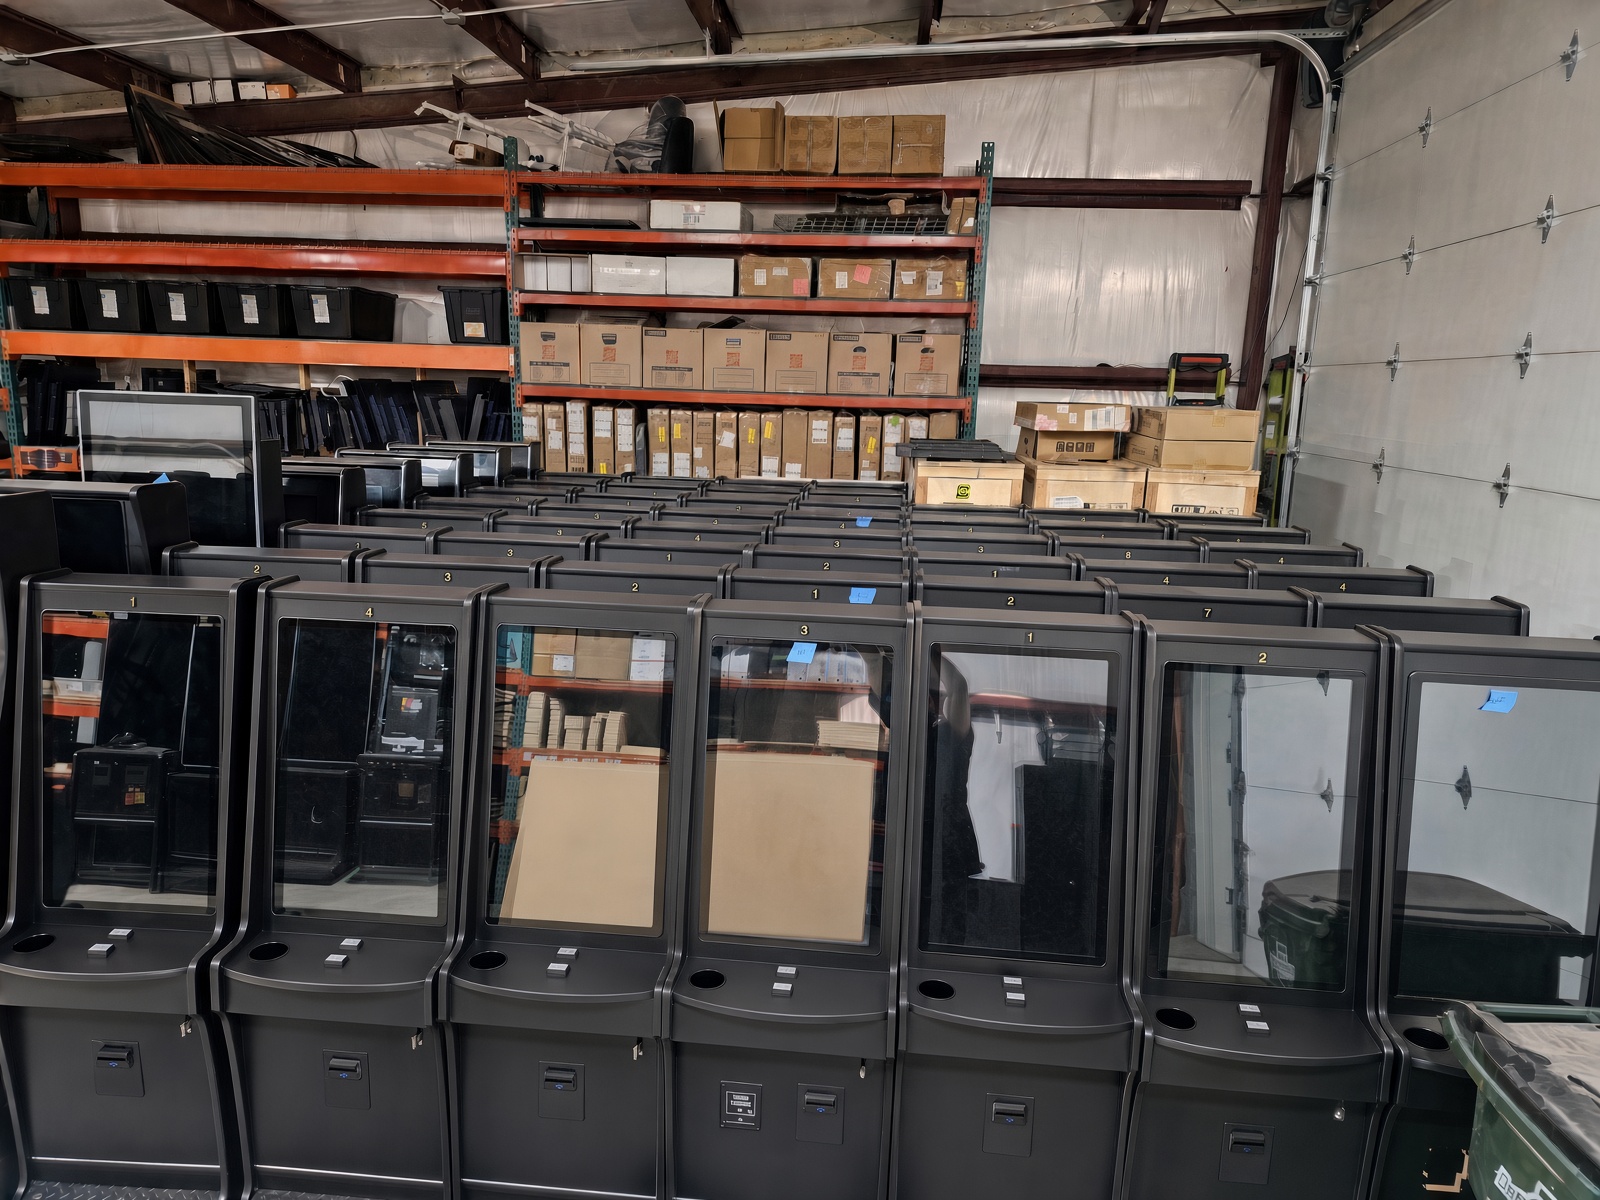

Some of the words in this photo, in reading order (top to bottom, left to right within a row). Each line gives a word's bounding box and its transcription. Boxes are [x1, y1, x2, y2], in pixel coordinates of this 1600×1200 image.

[421, 521, 427, 529] 5
[507, 548, 513, 557] 3
[978, 545, 984, 553] 3
[666, 553, 671, 561] 1
[1125, 551, 1131, 559] 8
[253, 564, 260, 574] 2
[823, 562, 830, 570] 2
[444, 572, 451, 582] 3
[992, 570, 997, 578] 1
[1163, 576, 1170, 585] 4
[632, 582, 639, 592] 2
[1339, 582, 1346, 591] 4
[812, 588, 818, 599] 1
[130, 596, 135, 607] 1
[1007, 596, 1014, 606] 2
[365, 607, 373, 618] 4
[1204, 608, 1211, 618] 7
[800, 624, 808, 635] 3
[1027, 632, 1033, 642] 1
[1258, 652, 1267, 664] 2
